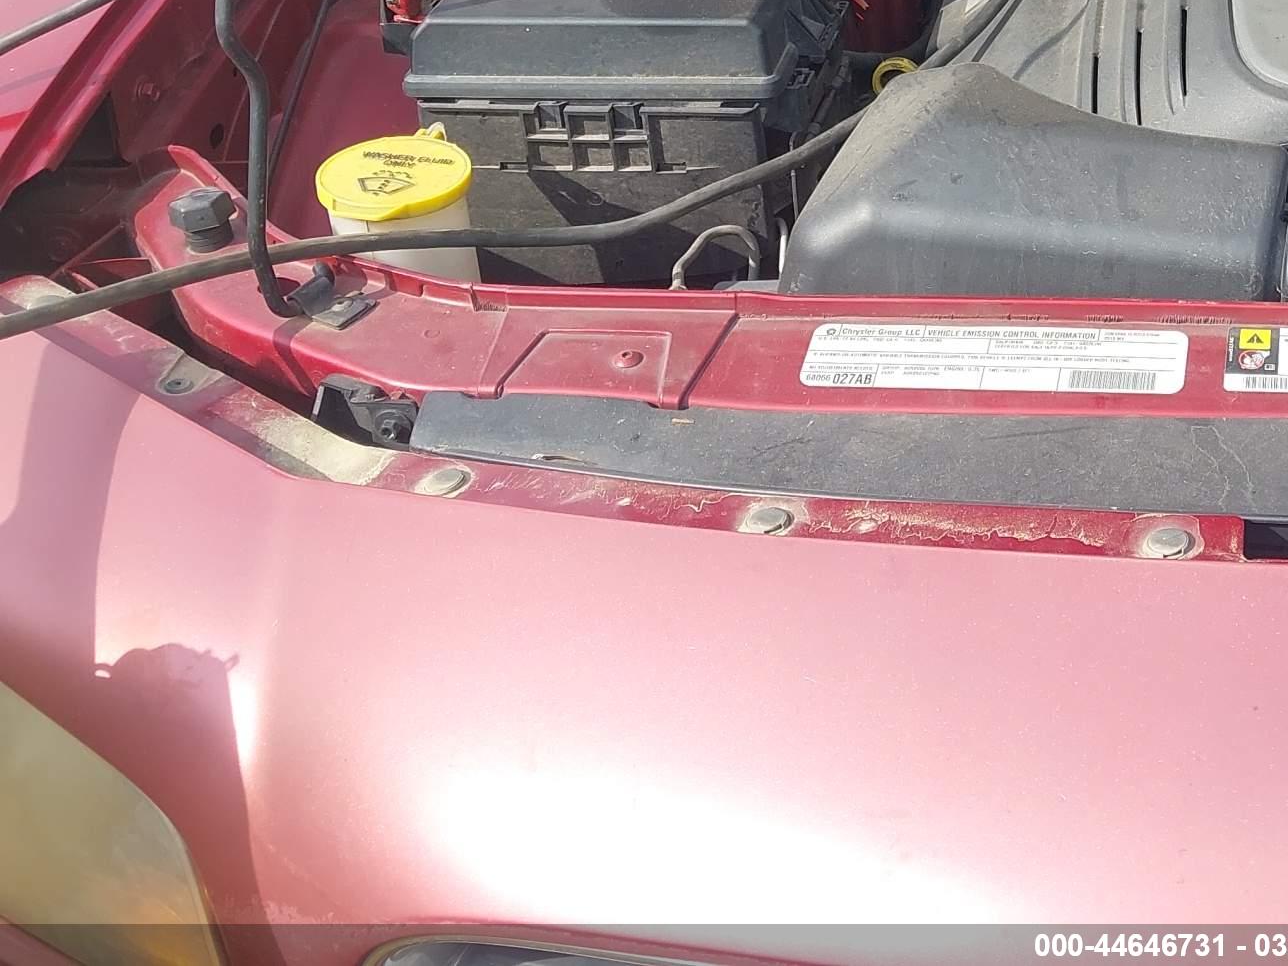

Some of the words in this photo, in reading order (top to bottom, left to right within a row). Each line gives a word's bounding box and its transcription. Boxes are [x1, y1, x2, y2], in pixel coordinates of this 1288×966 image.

[842, 328, 876, 336] Chrysler
[878, 328, 902, 338] Group
[905, 328, 921, 336] LLC
[927, 329, 961, 337] VEHICLE
[962, 330, 1000, 338] EMISSION
[1002, 330, 1039, 339] CONTROL
[1041, 331, 1096, 340] INFORMATION
[832, 373, 872, 385] 027AB
